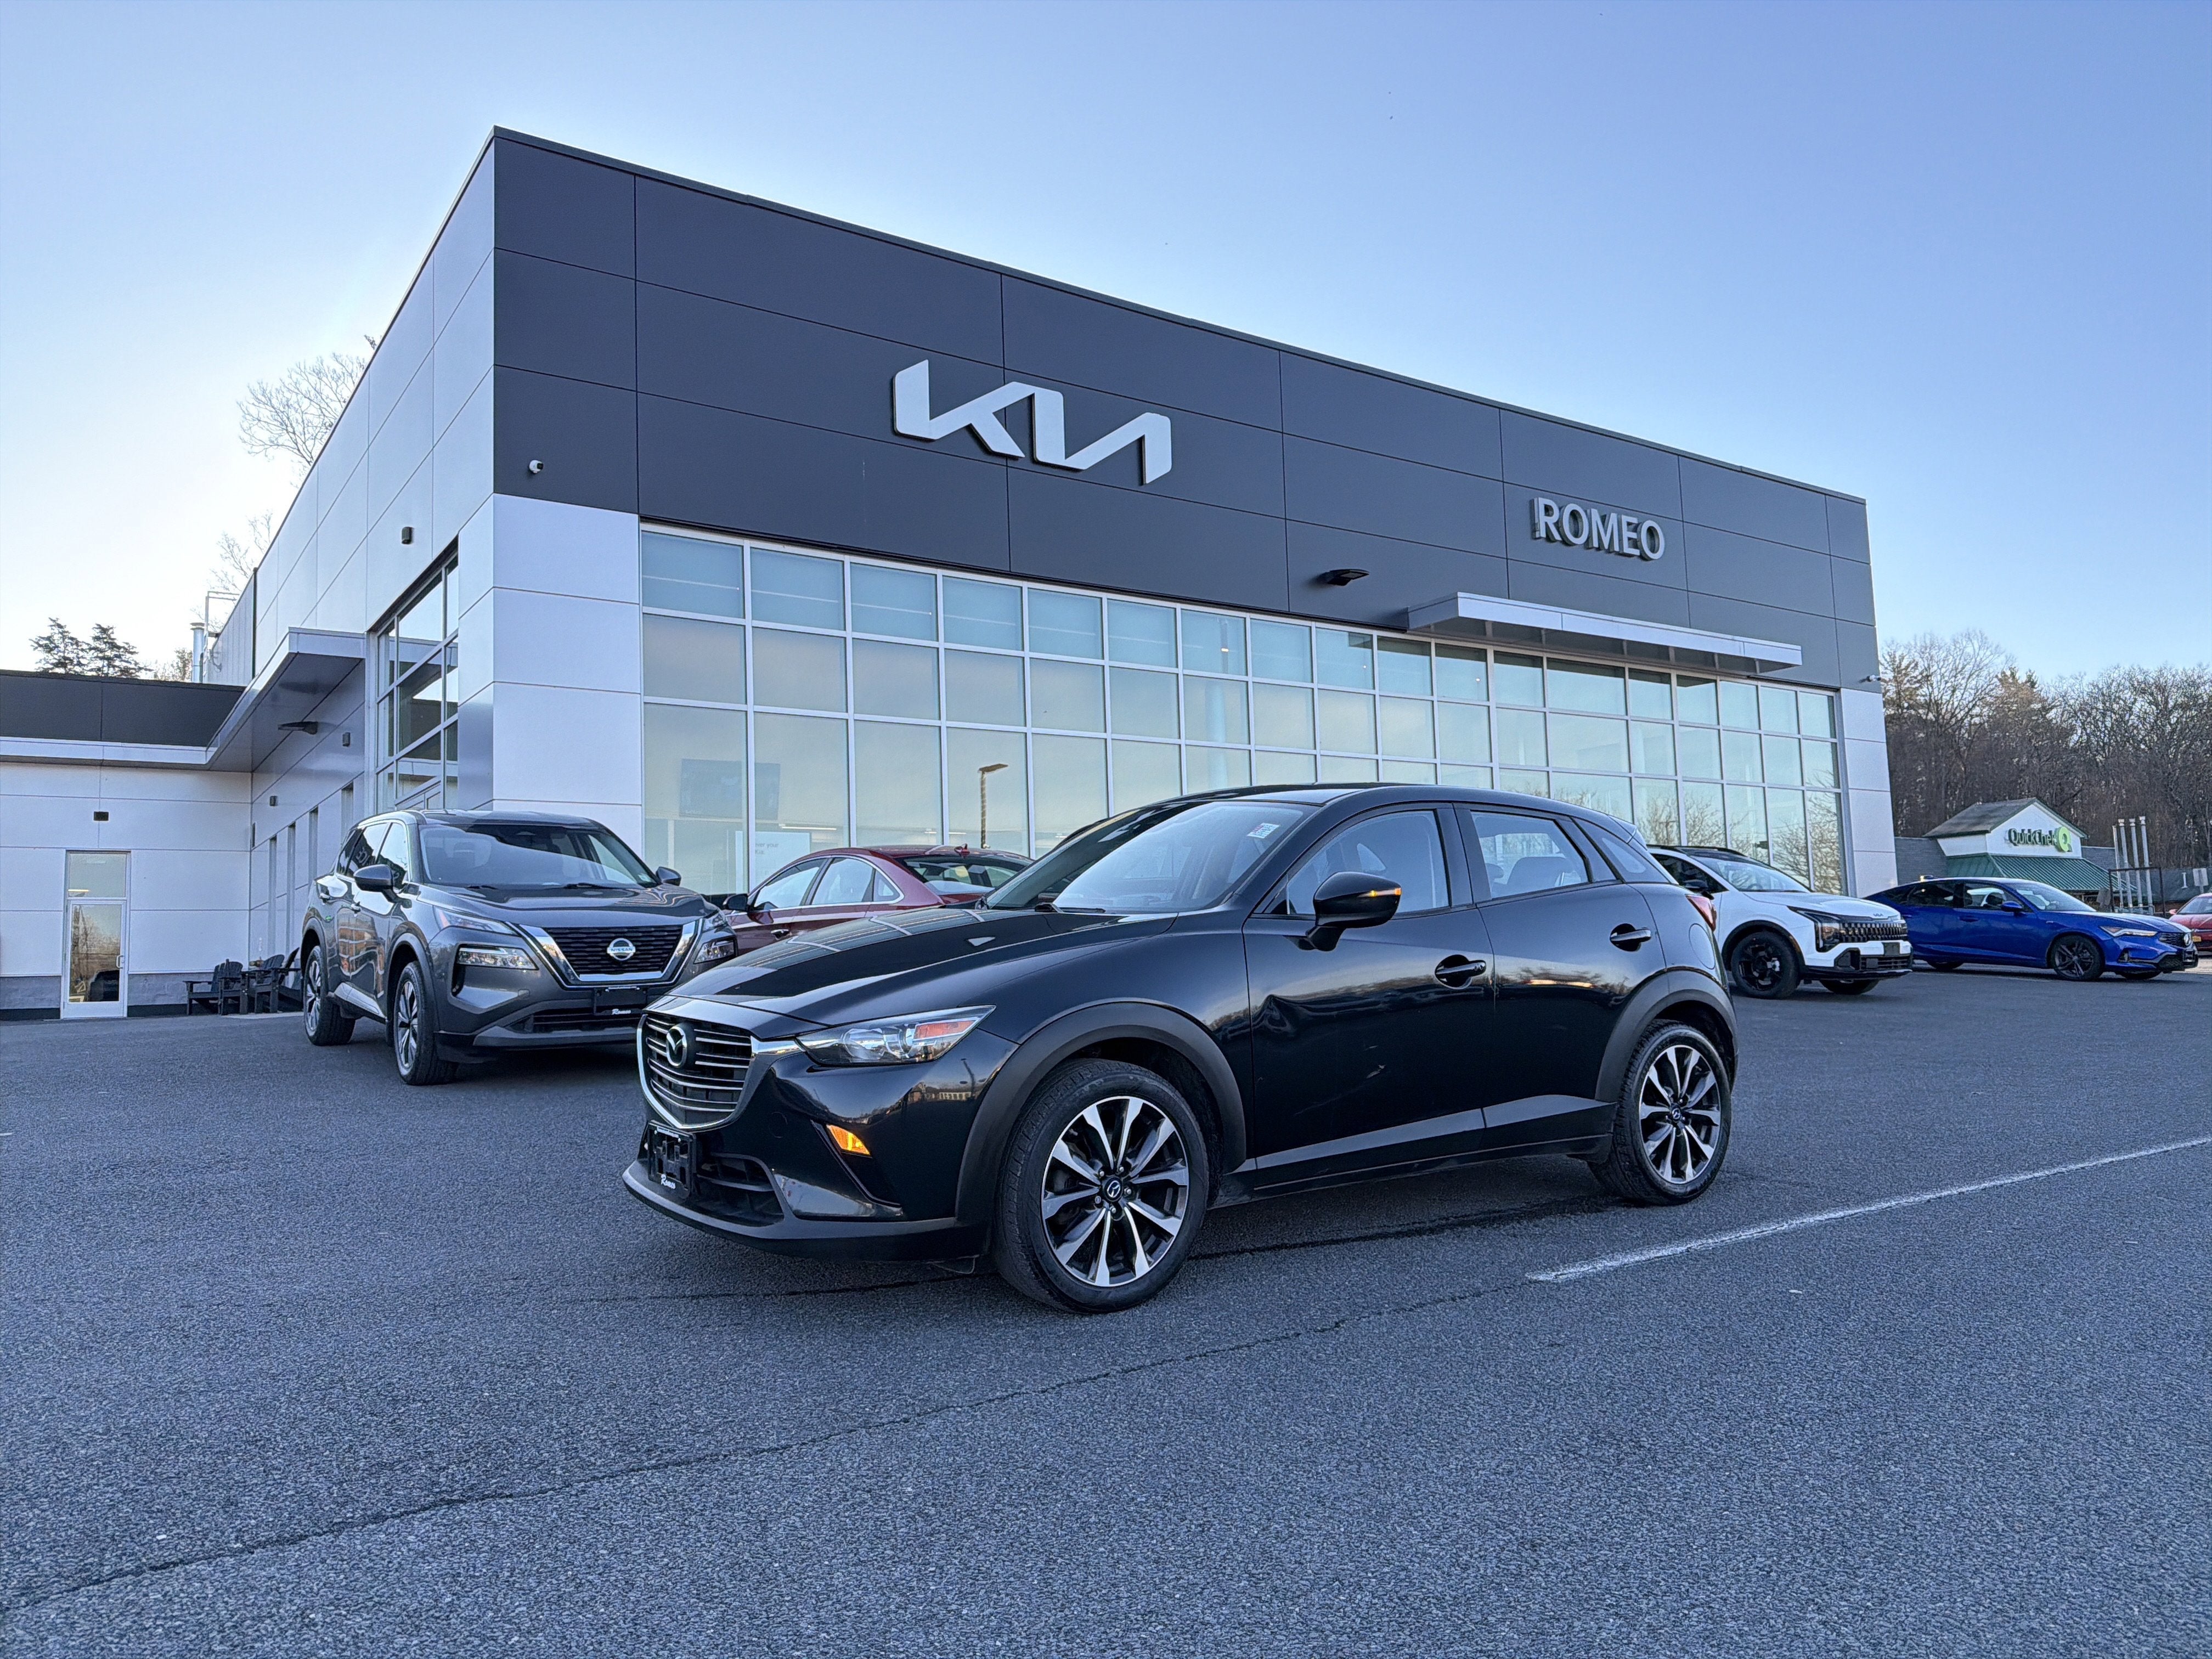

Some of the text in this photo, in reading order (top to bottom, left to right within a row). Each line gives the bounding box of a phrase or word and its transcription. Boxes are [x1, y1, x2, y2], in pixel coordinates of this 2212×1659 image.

[894, 359, 1172, 485] KIA
[1534, 497, 1665, 560] ROMEO
[661, 1174, 676, 1189] Romeo
